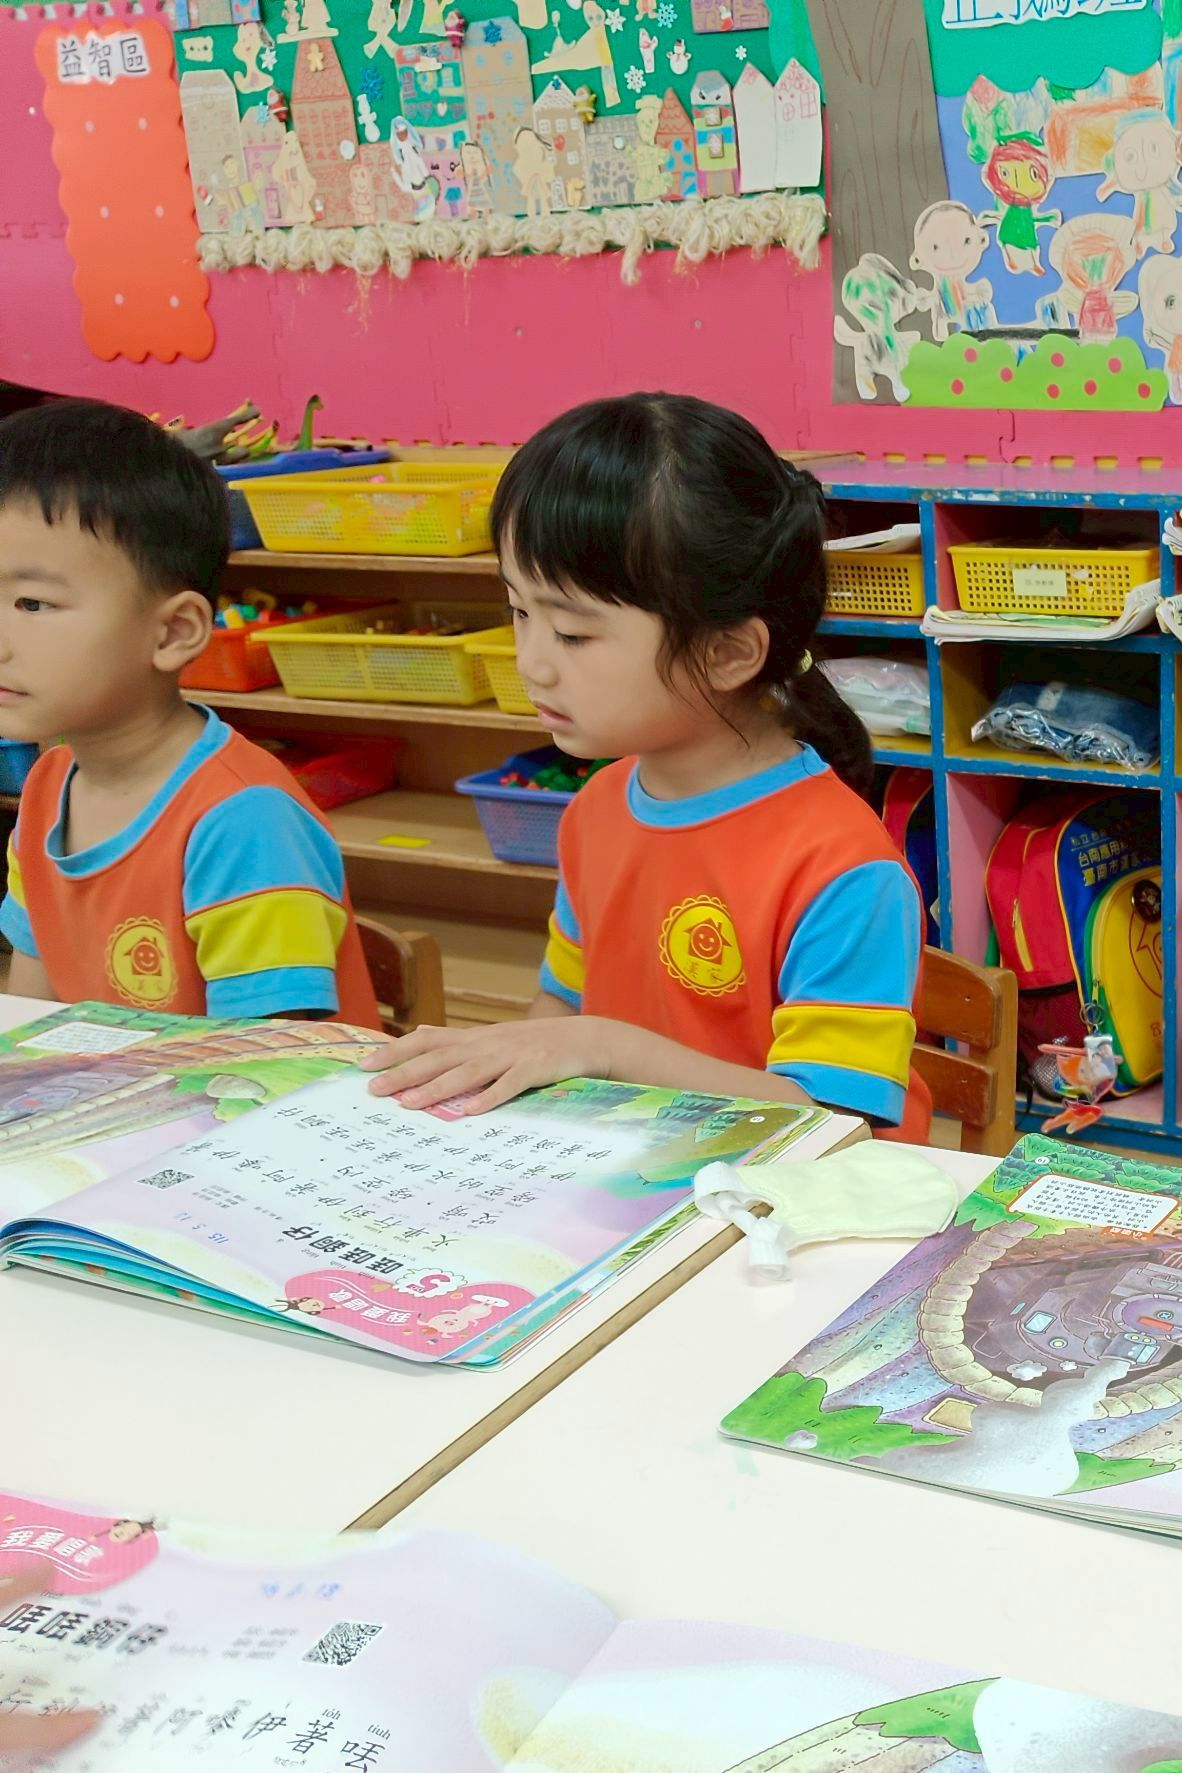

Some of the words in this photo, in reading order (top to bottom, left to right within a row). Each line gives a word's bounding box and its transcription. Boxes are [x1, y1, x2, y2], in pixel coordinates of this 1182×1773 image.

[61, 37, 148, 77] 益智區
[367, 1723, 392, 1741] tiuh
